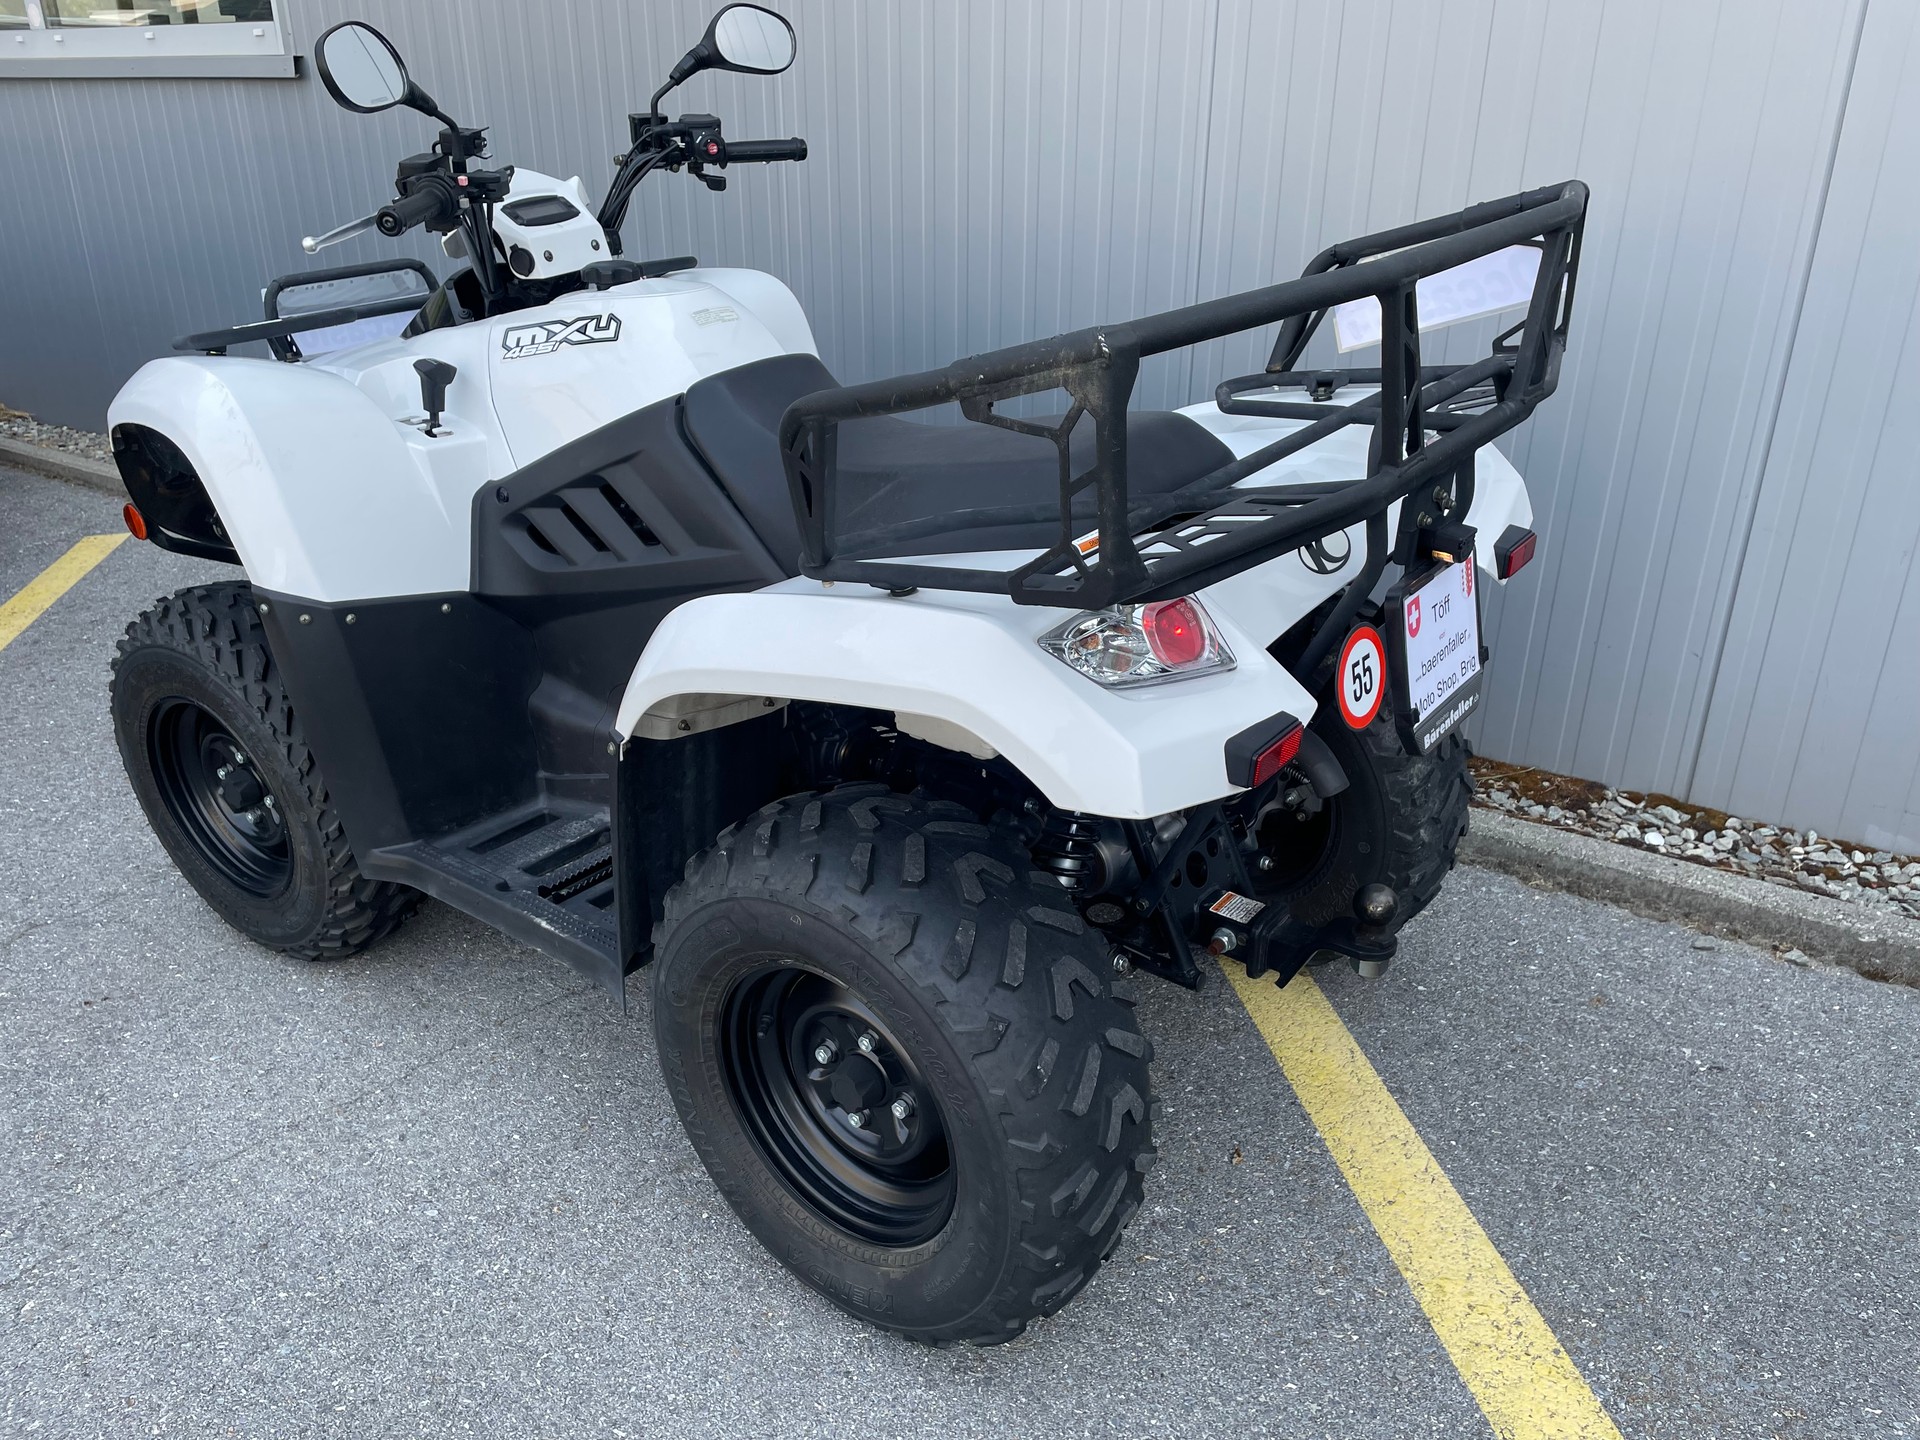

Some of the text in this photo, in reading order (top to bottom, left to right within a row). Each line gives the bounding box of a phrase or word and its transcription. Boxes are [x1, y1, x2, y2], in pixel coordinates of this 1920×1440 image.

[1431, 593, 1450, 623] Töff
[1352, 652, 1373, 702] 55
[1415, 656, 1476, 713] Moto Shop, Brig
[787, 1244, 895, 1315] KENDA
